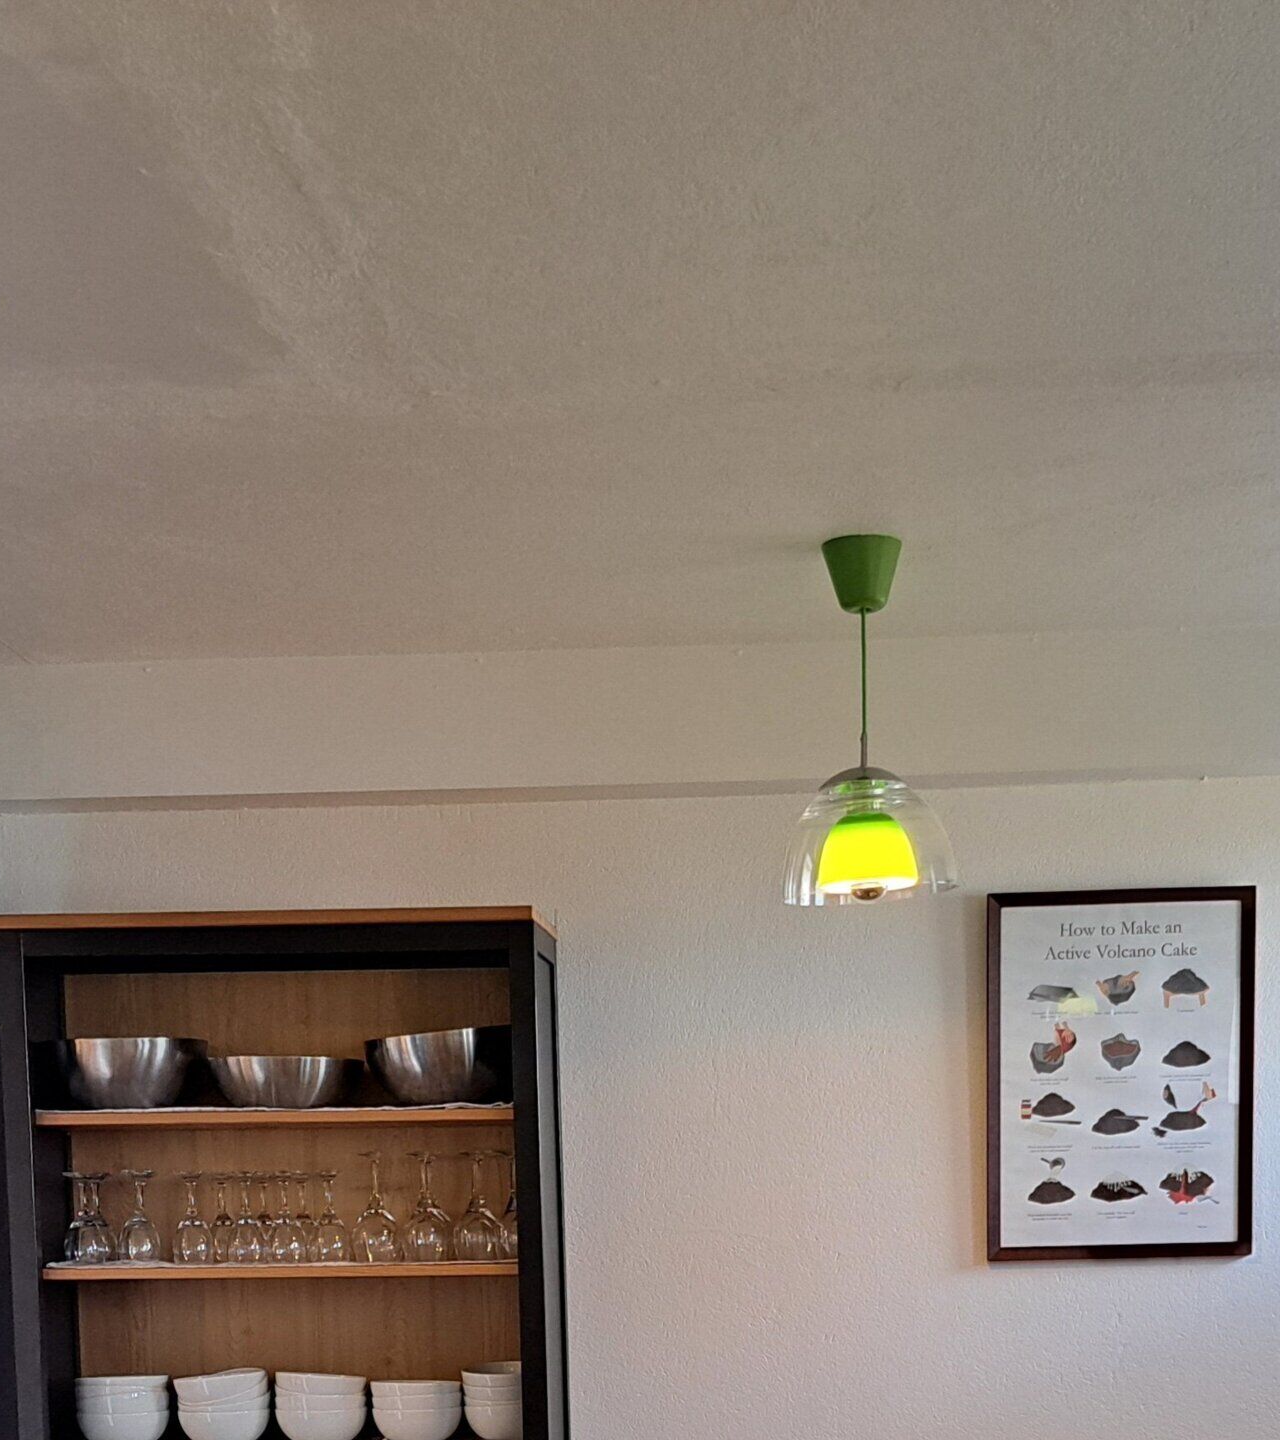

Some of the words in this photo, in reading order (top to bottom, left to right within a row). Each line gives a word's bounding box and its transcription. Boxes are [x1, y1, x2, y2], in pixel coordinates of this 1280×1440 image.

[1060, 922, 1096, 937] How
[1100, 924, 1116, 936] to
[1120, 920, 1160, 935] Make
[1164, 923, 1182, 934] an
[1044, 945, 1091, 960] Active
[1096, 943, 1156, 958] Volcano
[1160, 942, 1198, 957] Cake
